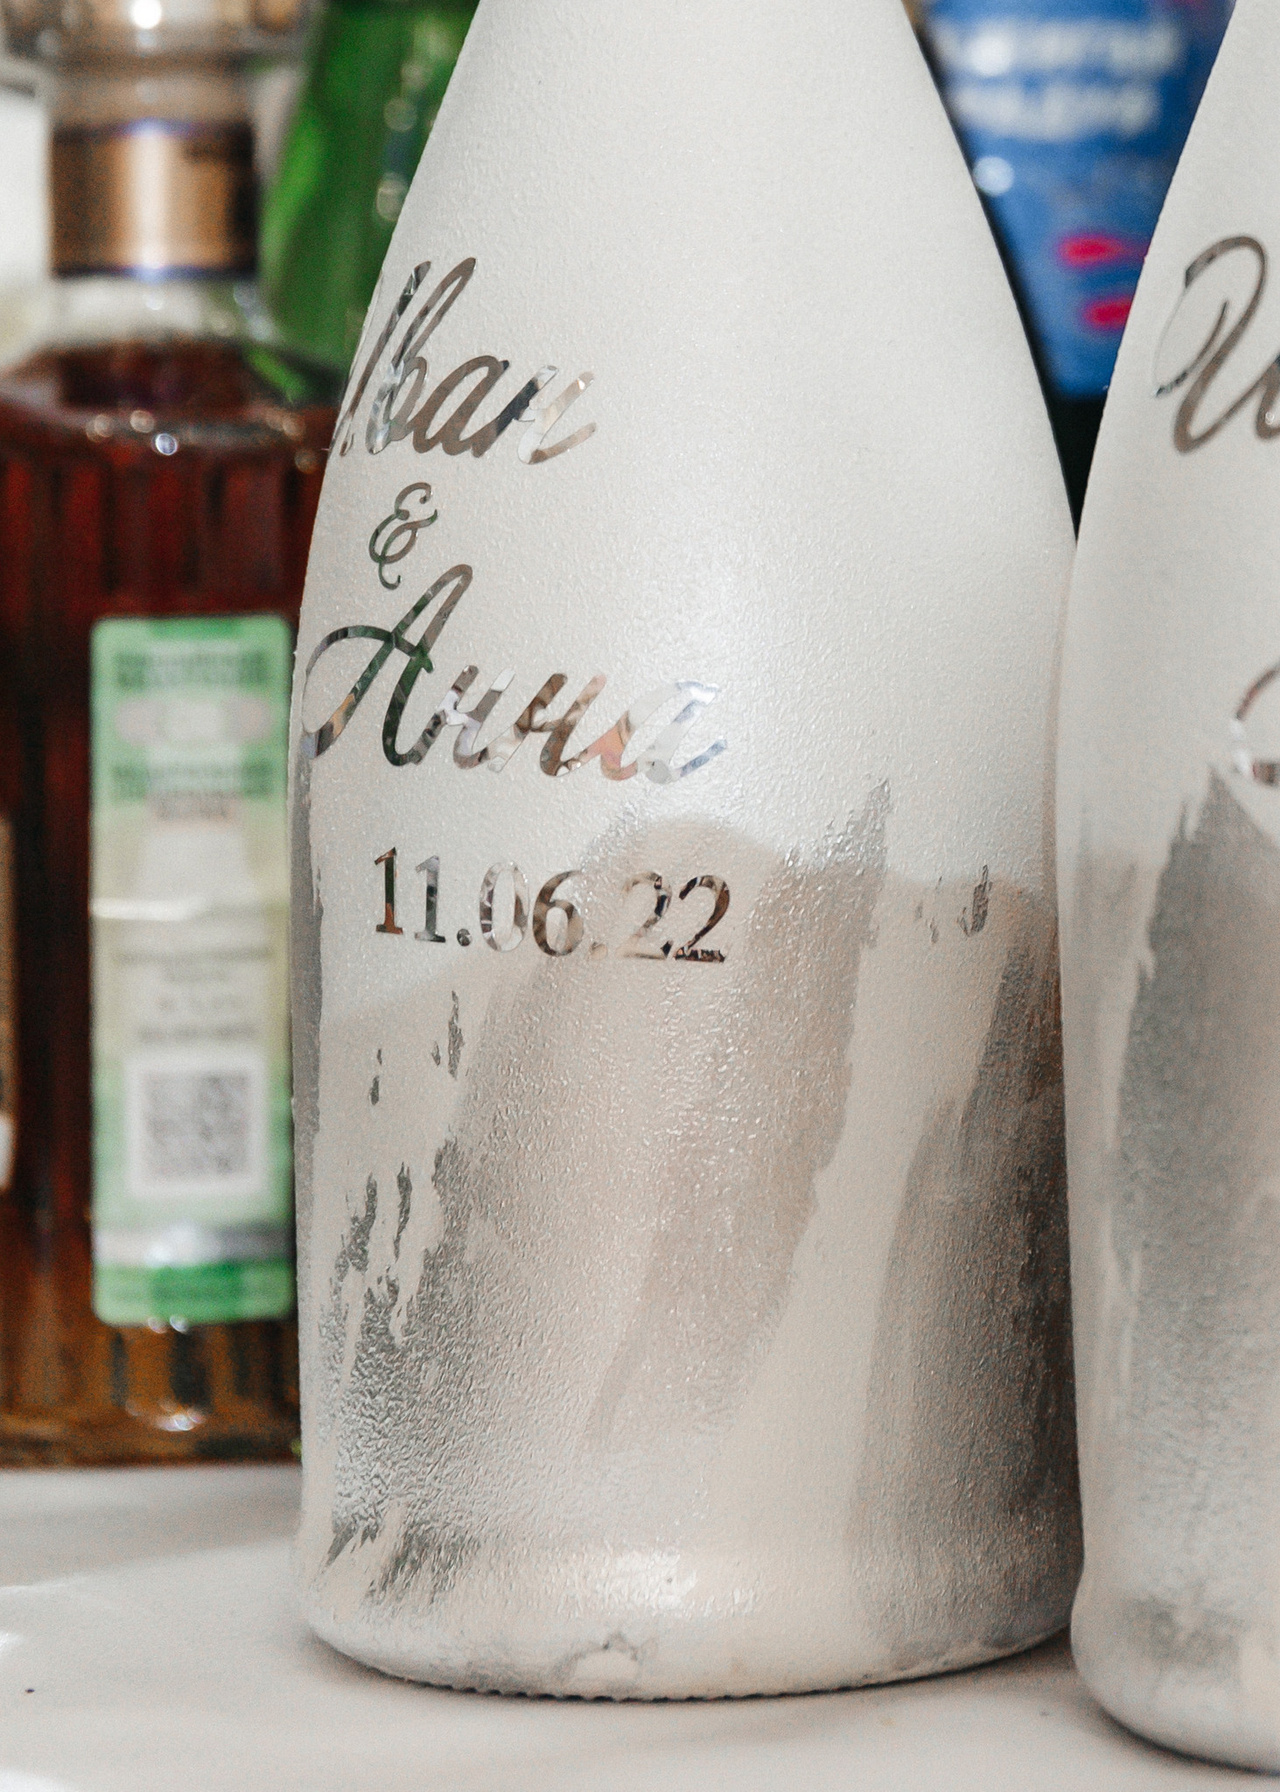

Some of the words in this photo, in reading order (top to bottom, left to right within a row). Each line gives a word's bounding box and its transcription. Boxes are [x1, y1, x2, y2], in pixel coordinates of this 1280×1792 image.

[367, 481, 438, 591] &
[300, 563, 728, 783] Анна
[373, 846, 734, 965] 11.06.22
